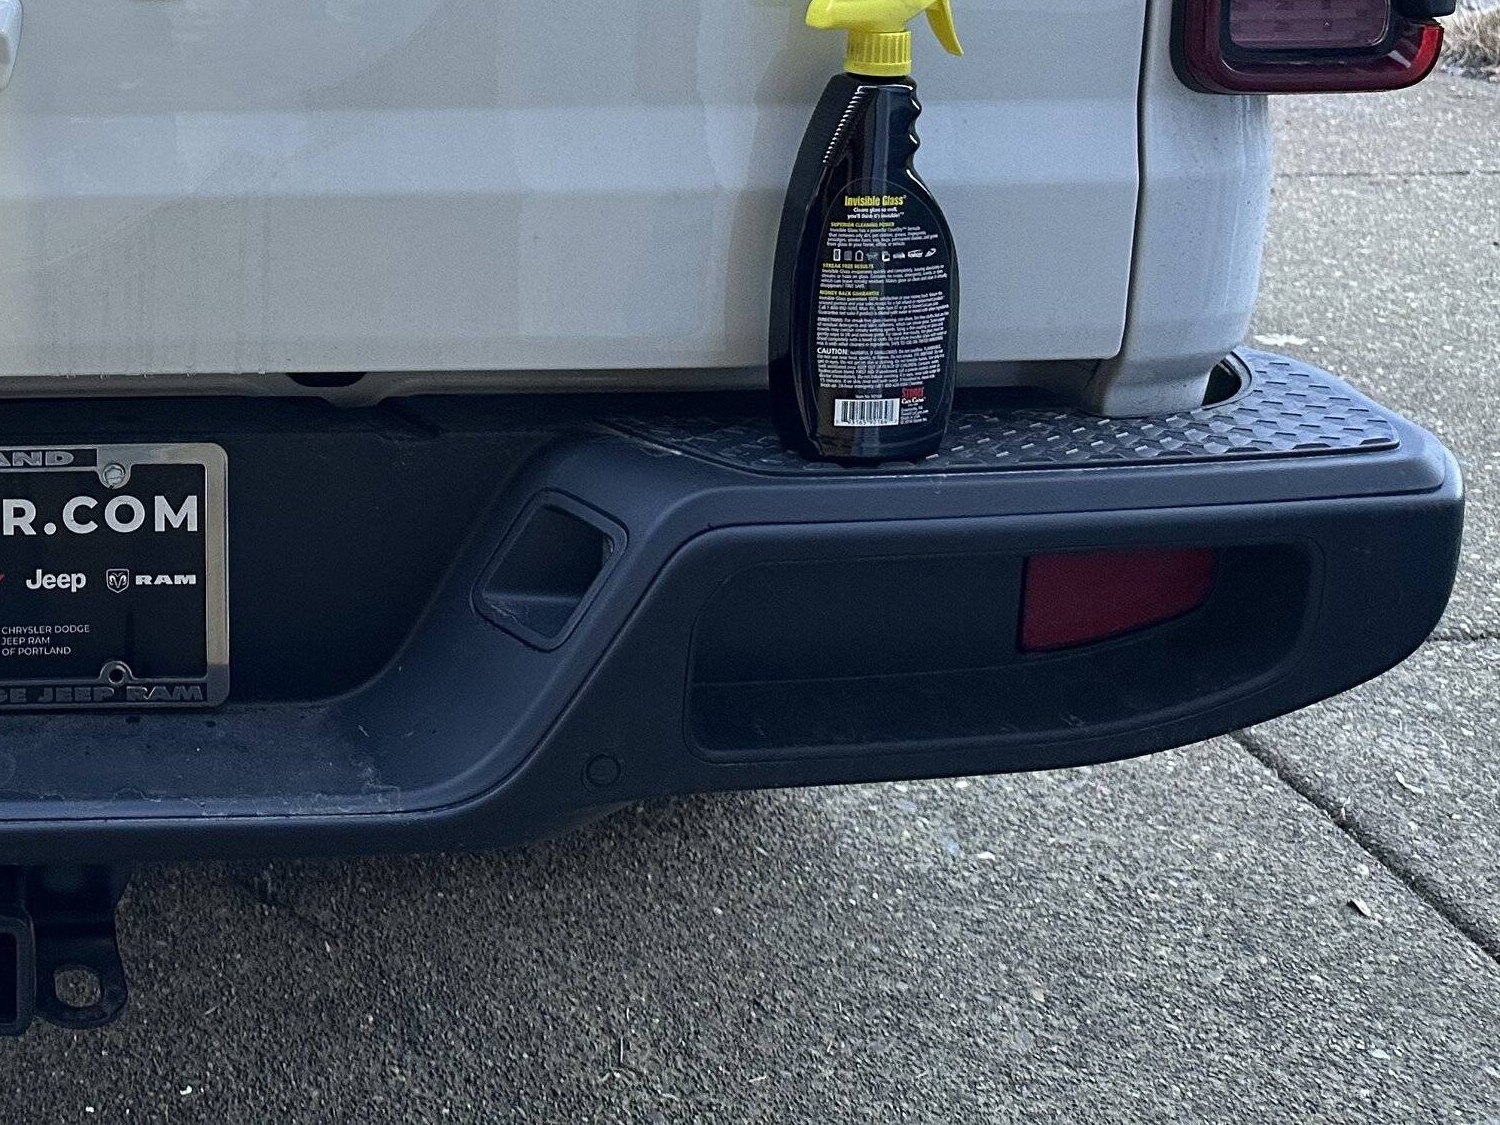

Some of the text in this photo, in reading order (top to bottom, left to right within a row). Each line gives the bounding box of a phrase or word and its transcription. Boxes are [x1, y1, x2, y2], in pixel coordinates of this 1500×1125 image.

[844, 195, 881, 206] Invisible
[25, 568, 87, 593] Jeep
[135, 574, 197, 586] RAM
[1, 624, 90, 635] CHRYSLER DODGE
[1, 636, 50, 646] JEEP RAM
[1, 646, 72, 656] OF PORTLAND
[37, 686, 115, 704] JEEP
[126, 685, 203, 702] RAM
